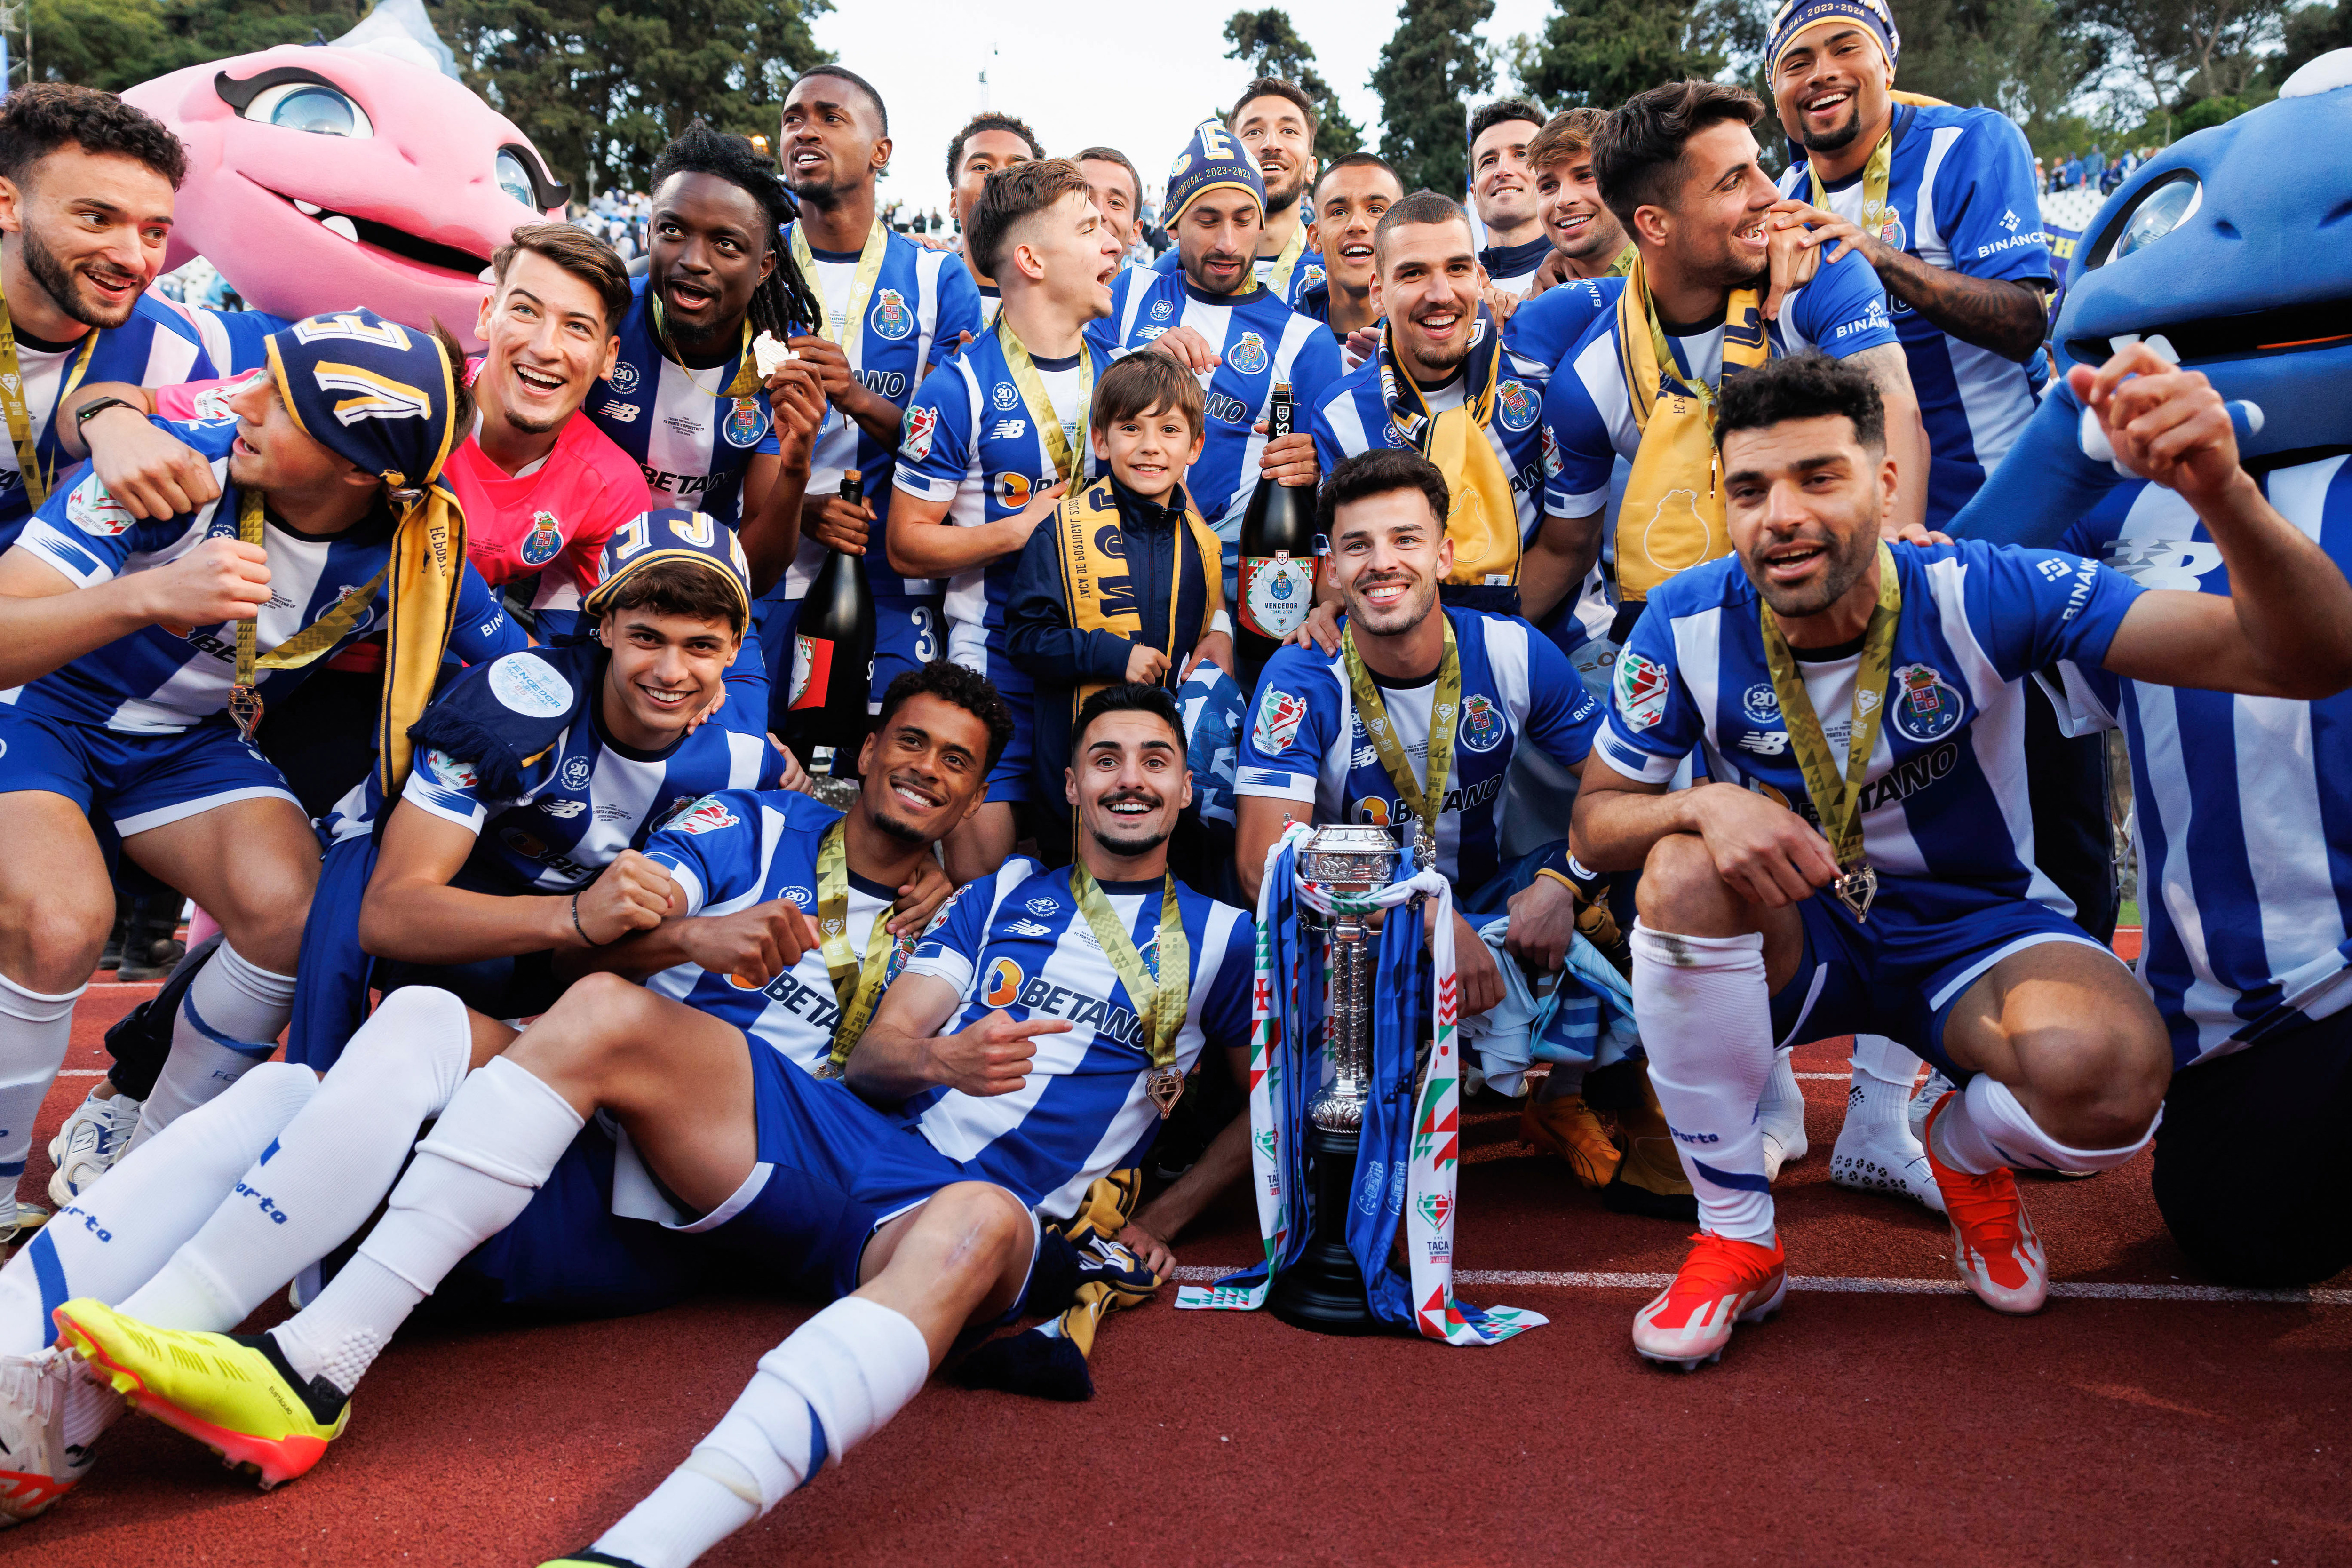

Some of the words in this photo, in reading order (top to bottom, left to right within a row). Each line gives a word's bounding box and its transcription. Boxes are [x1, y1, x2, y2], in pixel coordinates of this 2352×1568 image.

[1772, 16, 1804, 54] PORTUGAL
[1807, 3, 1865, 18] 2023-2024
[1177, 174, 1204, 199] PORTUGAL
[1206, 166, 1251, 181] 2023-2024
[1978, 232, 2046, 258] BINANCE
[614, 368, 633, 381] 20
[997, 388, 1013, 399] 20
[911, 606, 938, 663] 3
[507, 659, 561, 708] VENCEDOR
[519, 681, 548, 707] PORTUGAL
[1752, 692, 1778, 707] 20
[568, 763, 588, 777] 20
[1391, 773, 1502, 827] BTANO
[236, 1179, 288, 1225] orto
